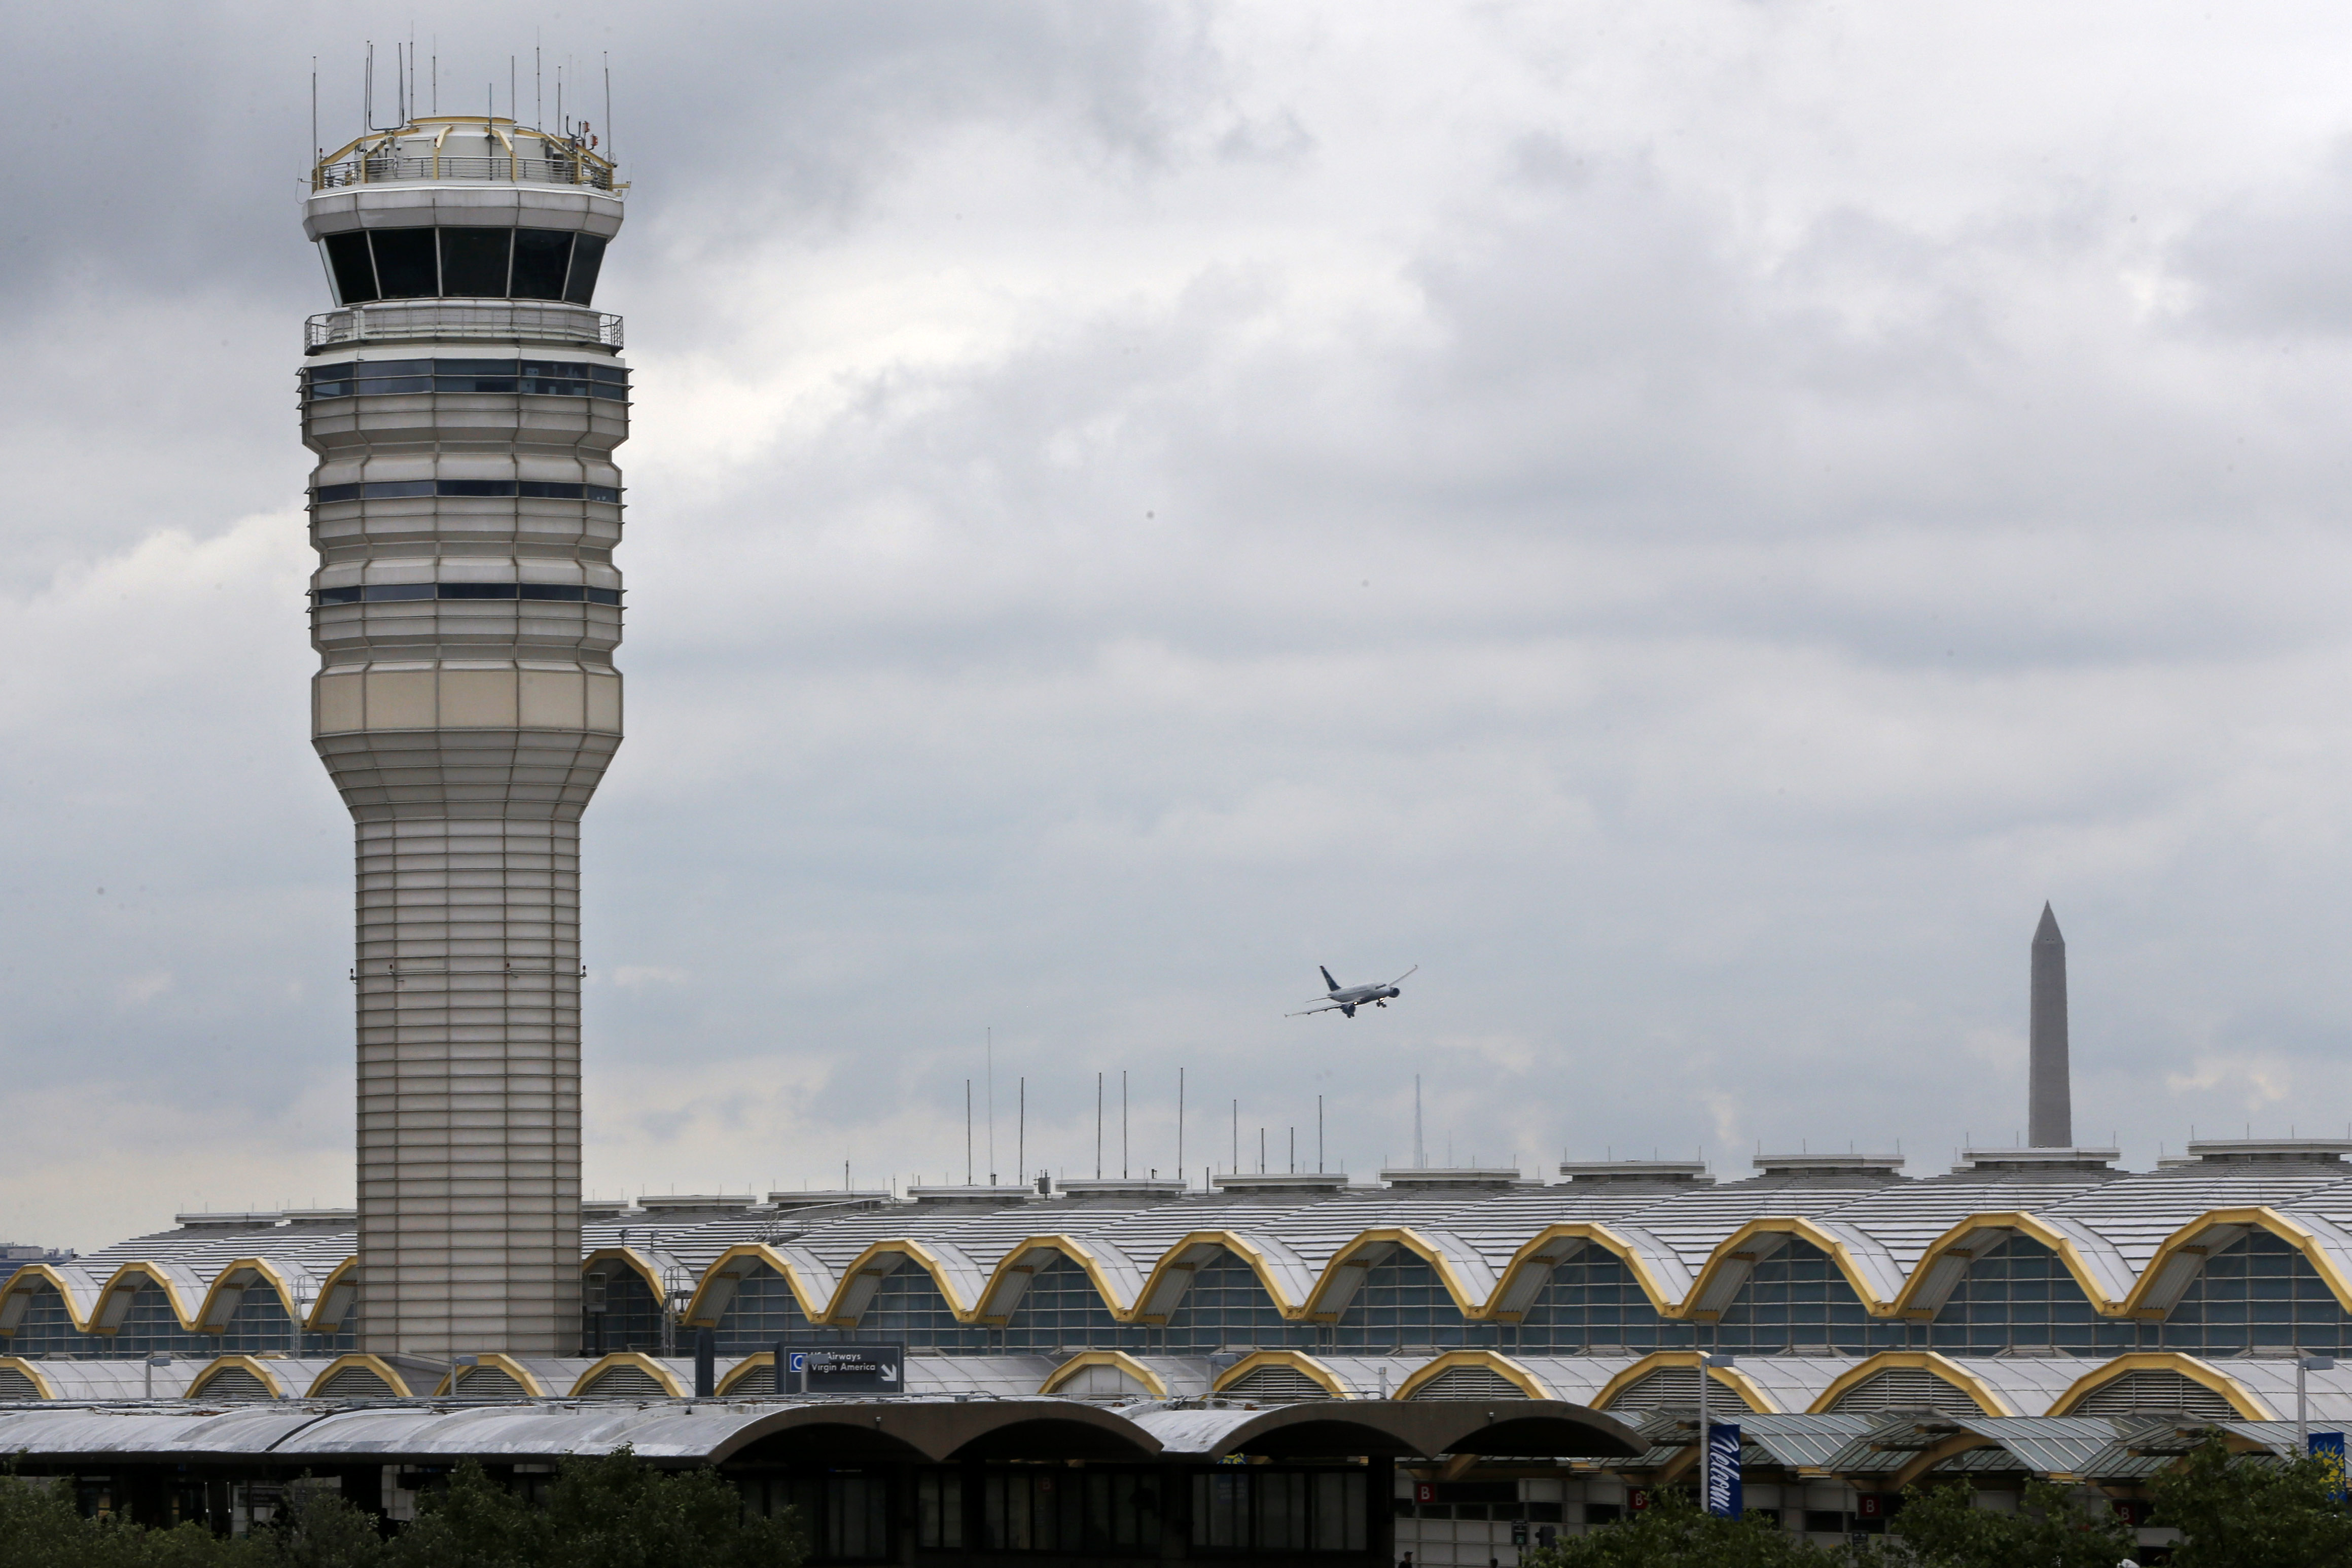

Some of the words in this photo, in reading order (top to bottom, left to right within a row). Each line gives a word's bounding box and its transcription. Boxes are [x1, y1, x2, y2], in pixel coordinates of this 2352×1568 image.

[827, 1352, 861, 1361] Airways
[812, 1363, 837, 1373] Virgin
[1421, 1486, 1430, 1500] B
[1635, 1493, 1643, 1506] B
[1866, 1500, 1875, 1512] B
[2121, 1507, 2130, 1520] B
